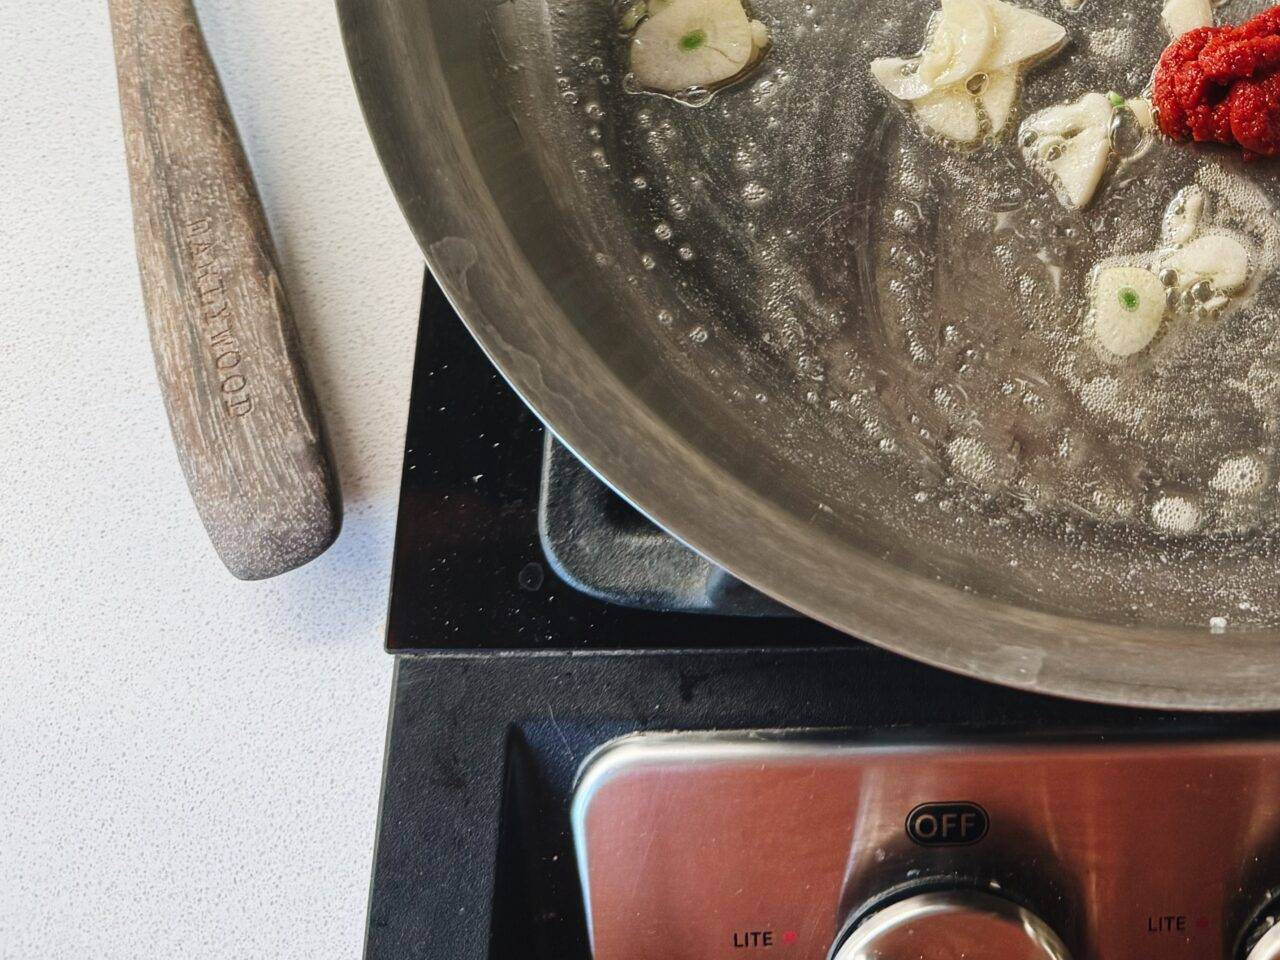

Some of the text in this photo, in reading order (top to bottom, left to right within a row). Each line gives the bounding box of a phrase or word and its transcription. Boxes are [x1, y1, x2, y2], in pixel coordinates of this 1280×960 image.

[914, 813, 977, 838] OFF
[1148, 915, 1187, 932] LITE
[733, 931, 773, 948] LITE
